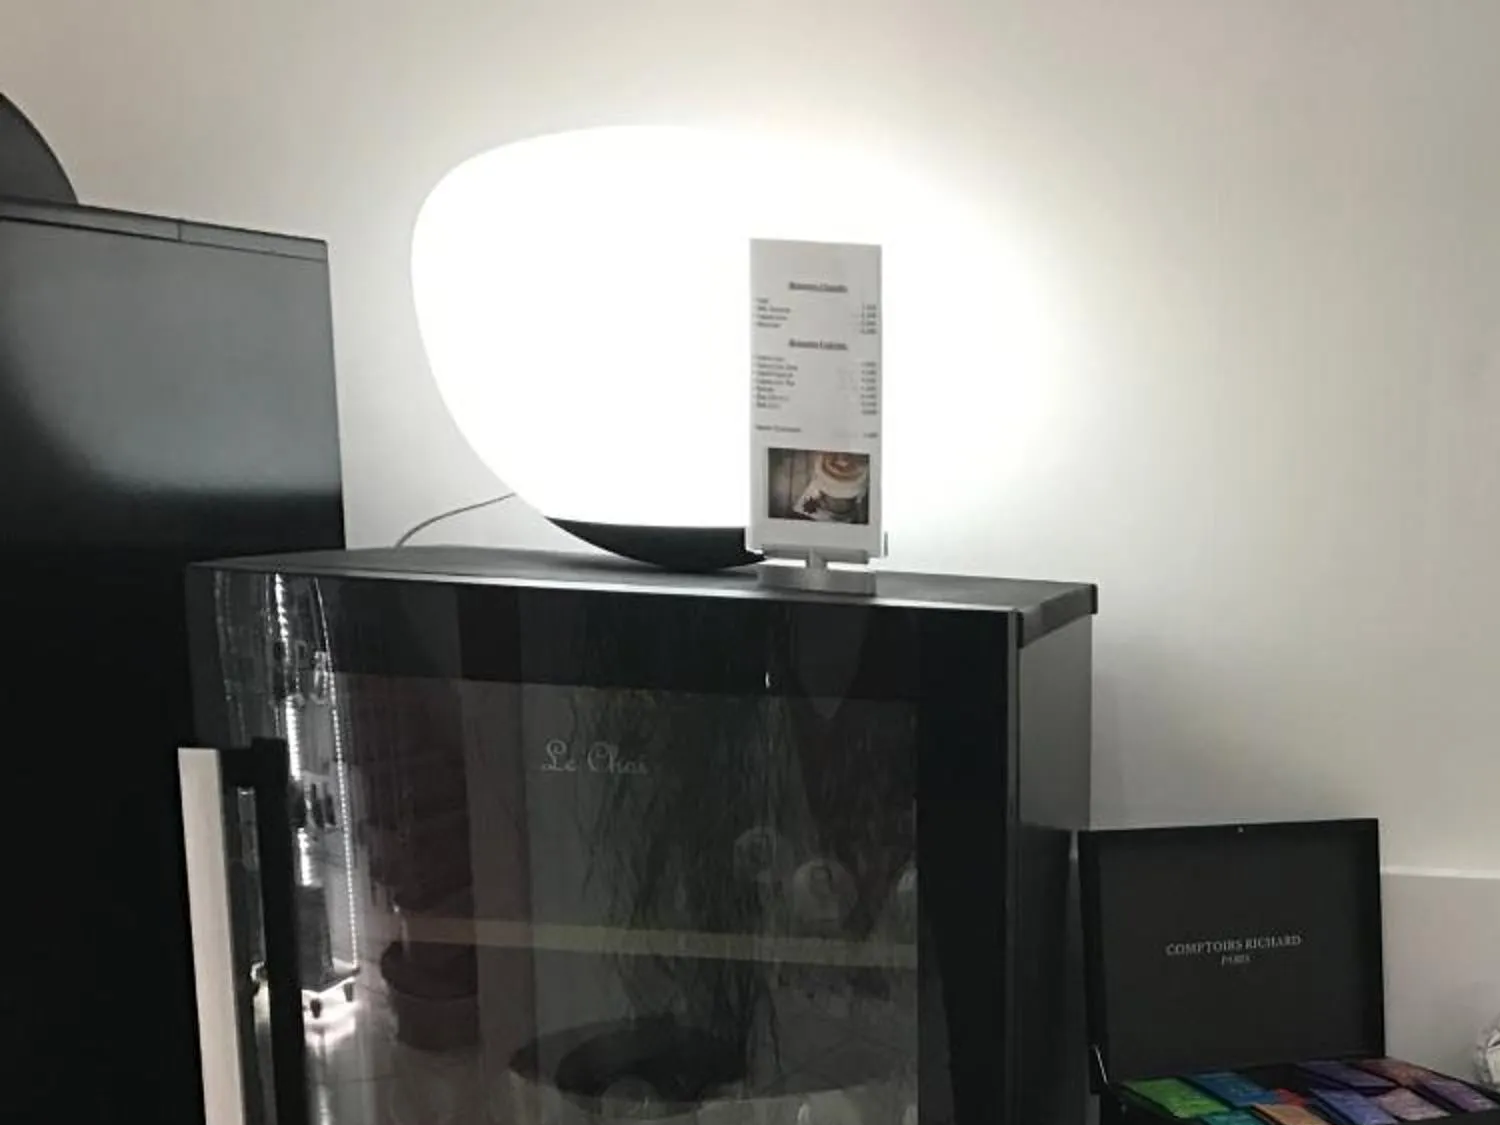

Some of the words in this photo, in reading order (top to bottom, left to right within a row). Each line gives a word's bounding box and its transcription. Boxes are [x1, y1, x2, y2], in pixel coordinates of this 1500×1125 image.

[541, 739, 576, 771] Le
[1165, 939, 1242, 956] COMPTOIRS
[1245, 935, 1302, 950] RICHARD
